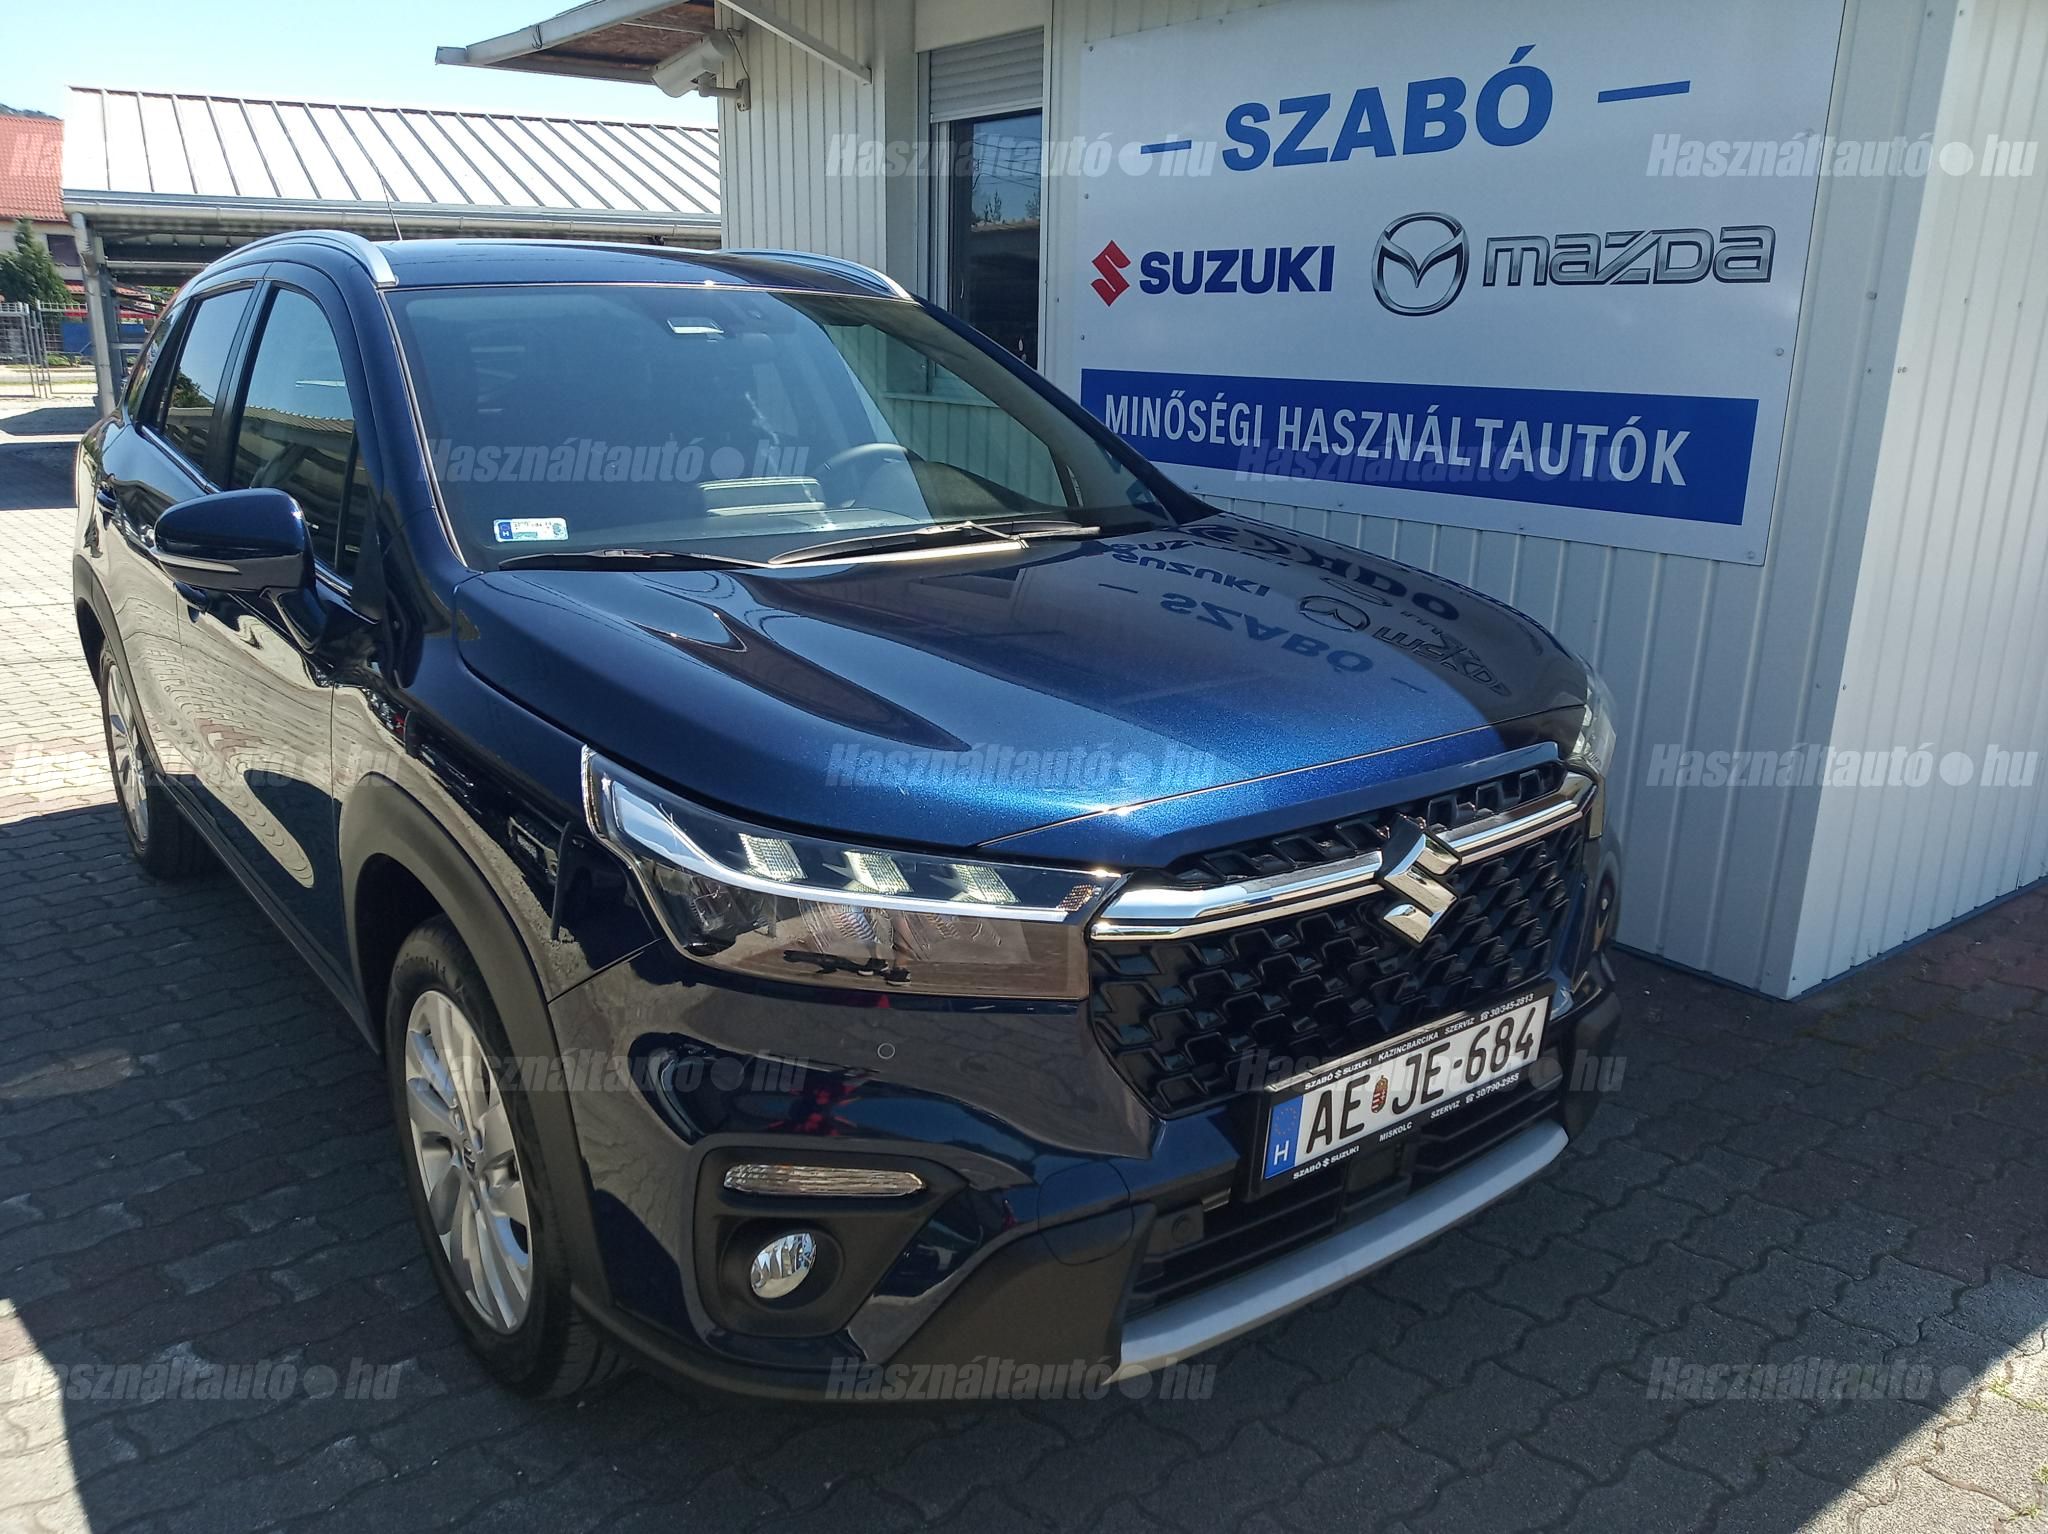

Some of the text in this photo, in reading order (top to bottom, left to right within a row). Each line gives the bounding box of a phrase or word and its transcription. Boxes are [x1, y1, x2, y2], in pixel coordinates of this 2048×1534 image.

[1222, 44, 1553, 171] SZABÓ
[1140, 245, 1335, 295] SUZUKI
[1104, 388, 1691, 487] MINŐSÉGI HASZNÁLTAUTÓK
[1273, 1007, 1536, 1165] H AE JE-684
[1304, 1072, 1333, 1091] SZABÓ
[1342, 1059, 1372, 1076] SUZUKI
[1378, 1031, 1439, 1061] KAZINCBARCIKA
[1444, 1017, 1475, 1034] SZERVIZ
[1293, 1161, 1322, 1180] SZABÓ
[1330, 1145, 1360, 1163] SUZUKI
[1379, 1121, 1413, 1142] MISKOLC
[1430, 1100, 1460, 1119] SZERVIZ
